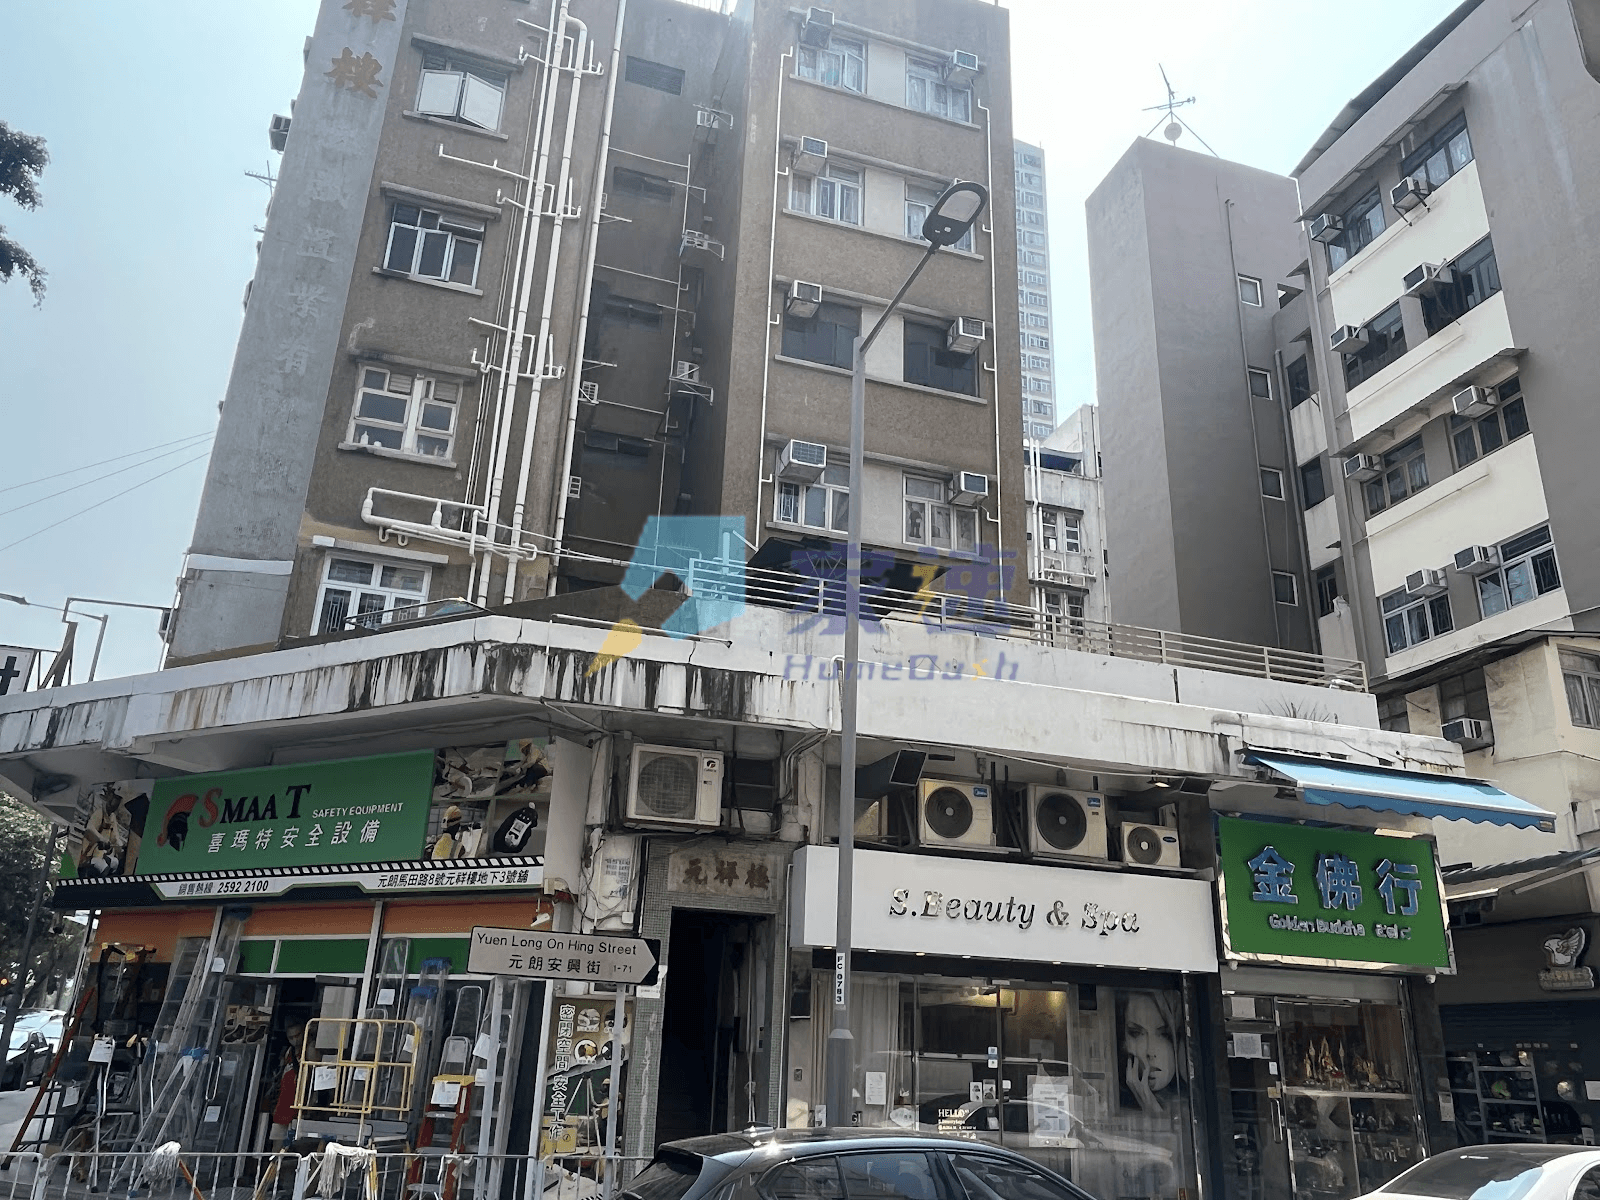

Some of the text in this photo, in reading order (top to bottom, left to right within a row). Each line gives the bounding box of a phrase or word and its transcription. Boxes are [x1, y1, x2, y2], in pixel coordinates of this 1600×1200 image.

[312, 802, 404, 819] SAFETY EQUIPMENT
[207, 819, 381, 854] 喜瑪特安全設備
[217, 880, 242, 893] 2592
[243, 879, 269, 892] 2100
[1247, 845, 1422, 916] 金佛行
[888, 887, 1140, 937] S.Beauty & Spa
[477, 932, 637, 956] Yuen Long On Hing Street
[508, 954, 633, 975] 元朗安興街 1-71
